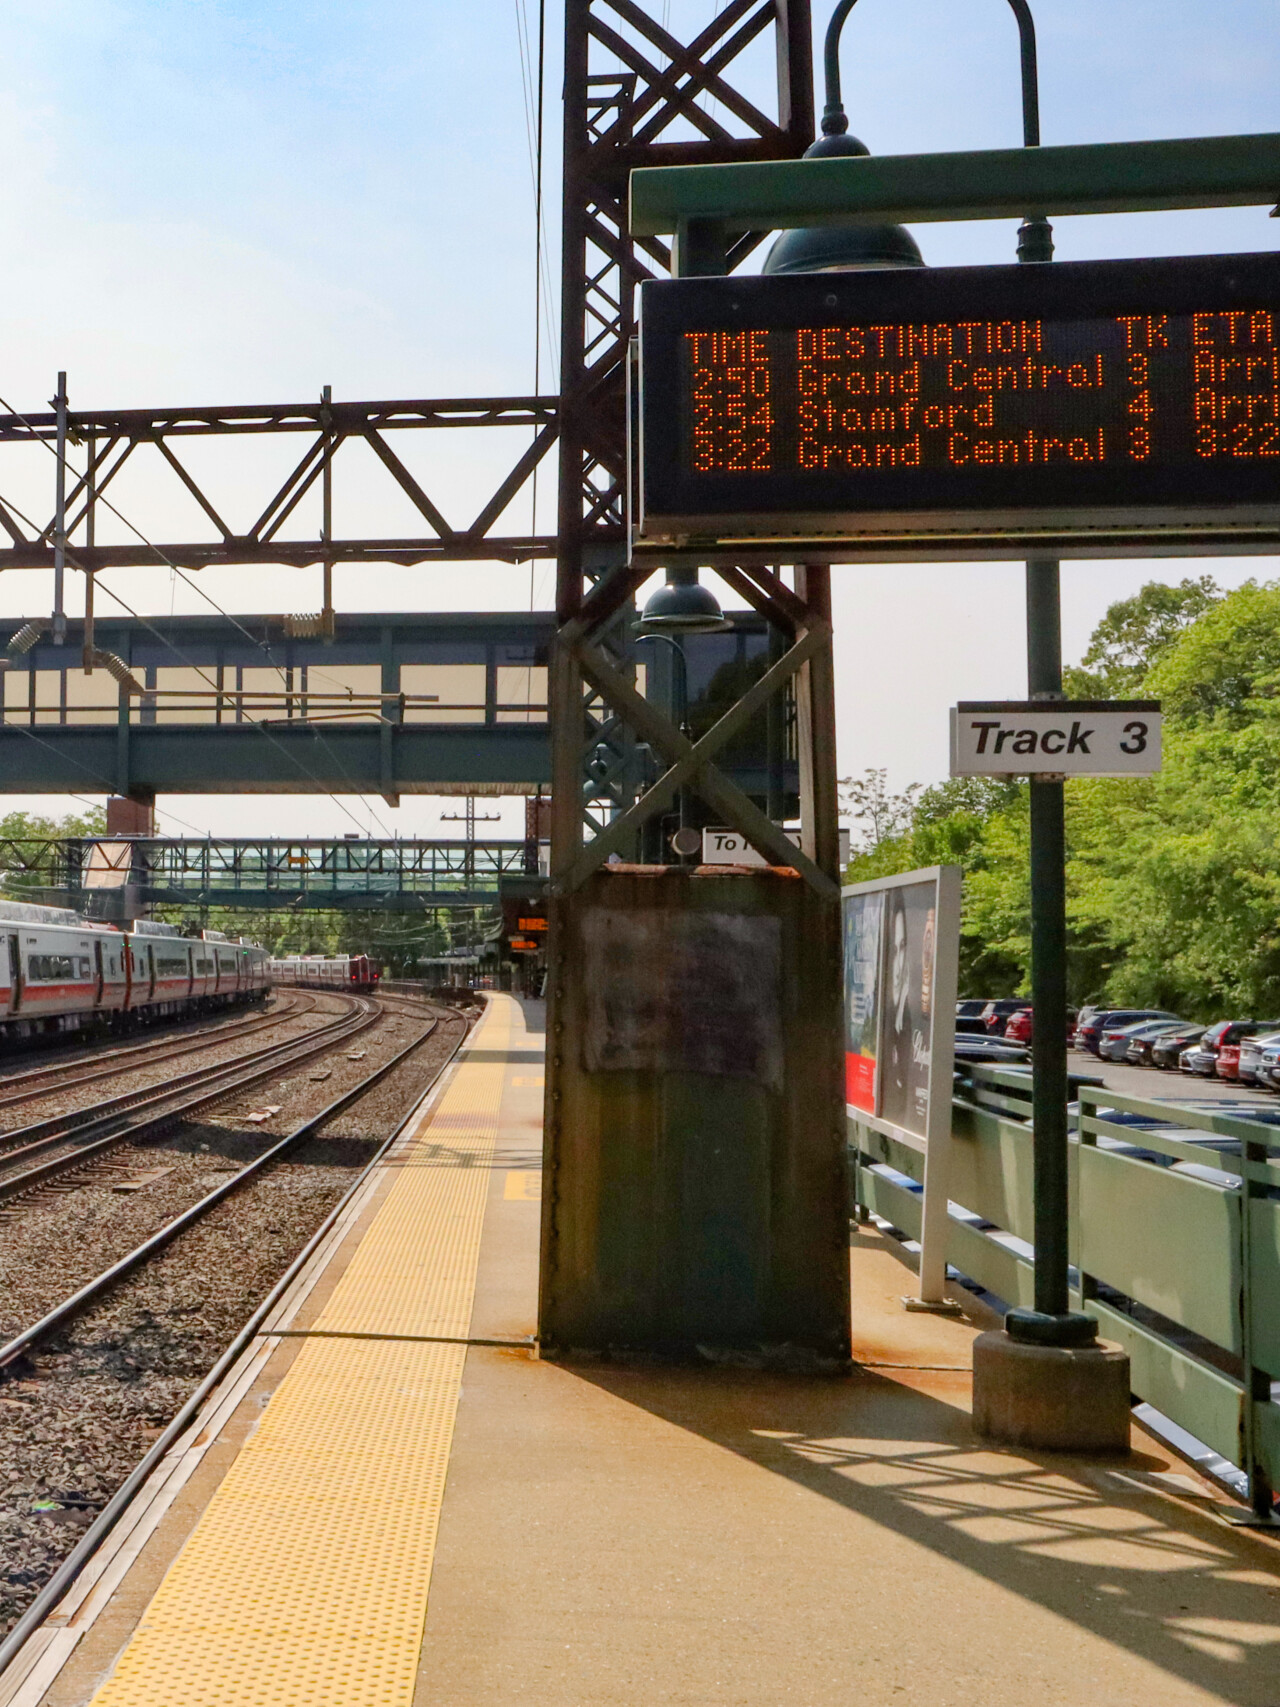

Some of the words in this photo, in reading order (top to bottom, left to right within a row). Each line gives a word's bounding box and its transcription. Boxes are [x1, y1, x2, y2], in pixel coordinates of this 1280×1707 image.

[683, 330, 770, 363] TIME
[797, 319, 1042, 360] DESTINATION
[1116, 314, 1168, 348] TK
[1193, 310, 1272, 346] ETA
[693, 366, 770, 399] 2:50
[798, 360, 919, 396] Grand
[948, 354, 1103, 391] Central
[1128, 352, 1149, 385] 3
[693, 402, 775, 435] 2:54
[799, 395, 993, 432] Stamford
[1127, 389, 1154, 422] 4
[694, 437, 771, 471] 3:22
[799, 432, 920, 468] Grand
[949, 427, 1104, 464] Central
[1129, 426, 1150, 459] 3
[1195, 422, 1280, 457] 3:22
[970, 721, 1095, 755] Track
[1120, 721, 1149, 755] 3
[714, 835, 737, 851] To
